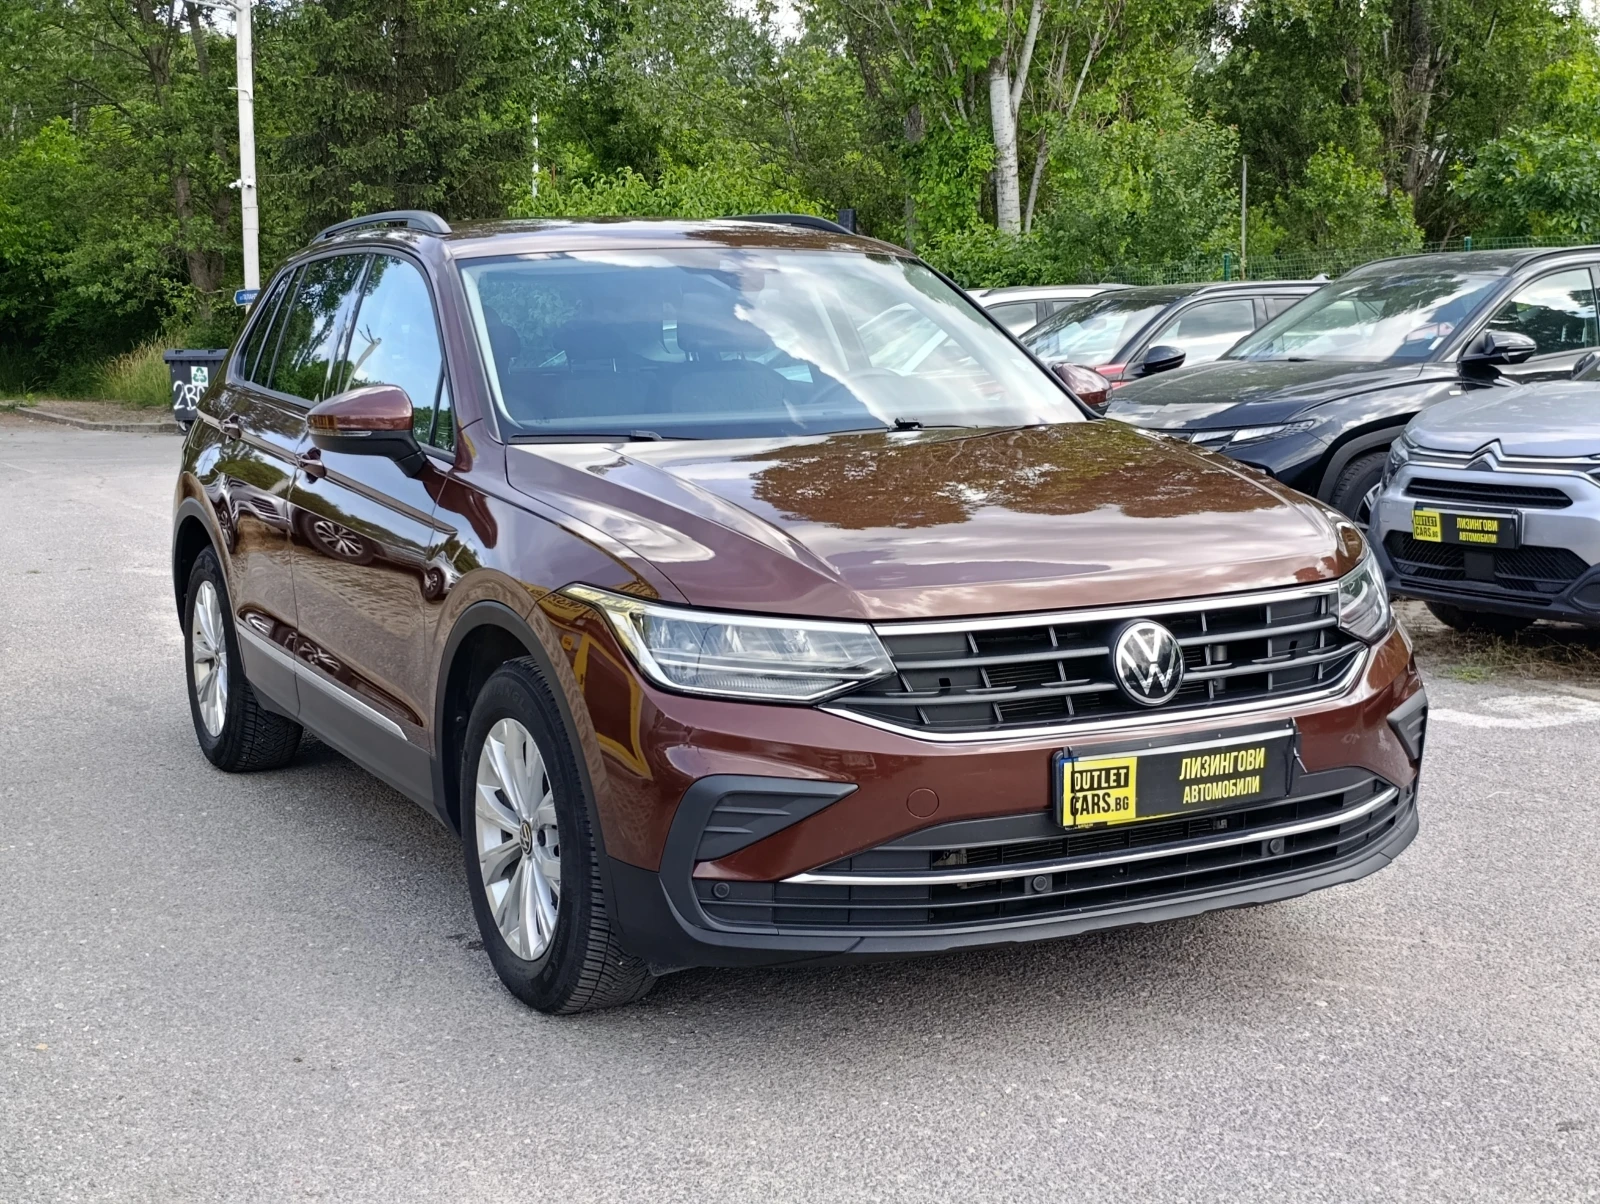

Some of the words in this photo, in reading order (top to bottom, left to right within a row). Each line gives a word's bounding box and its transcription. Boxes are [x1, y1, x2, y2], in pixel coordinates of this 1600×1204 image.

[1456, 517, 1498, 532] ЛИЗИНГОВИ
[1459, 531, 1497, 544] АВТОМОБИЛИ
[1179, 747, 1265, 780] ЛИЗИНГОВИ
[1074, 769, 1128, 790] OUTLET
[1183, 775, 1260, 804] АВТОМОБИЛИ
[1070, 792, 1129, 817] CARS.BG
